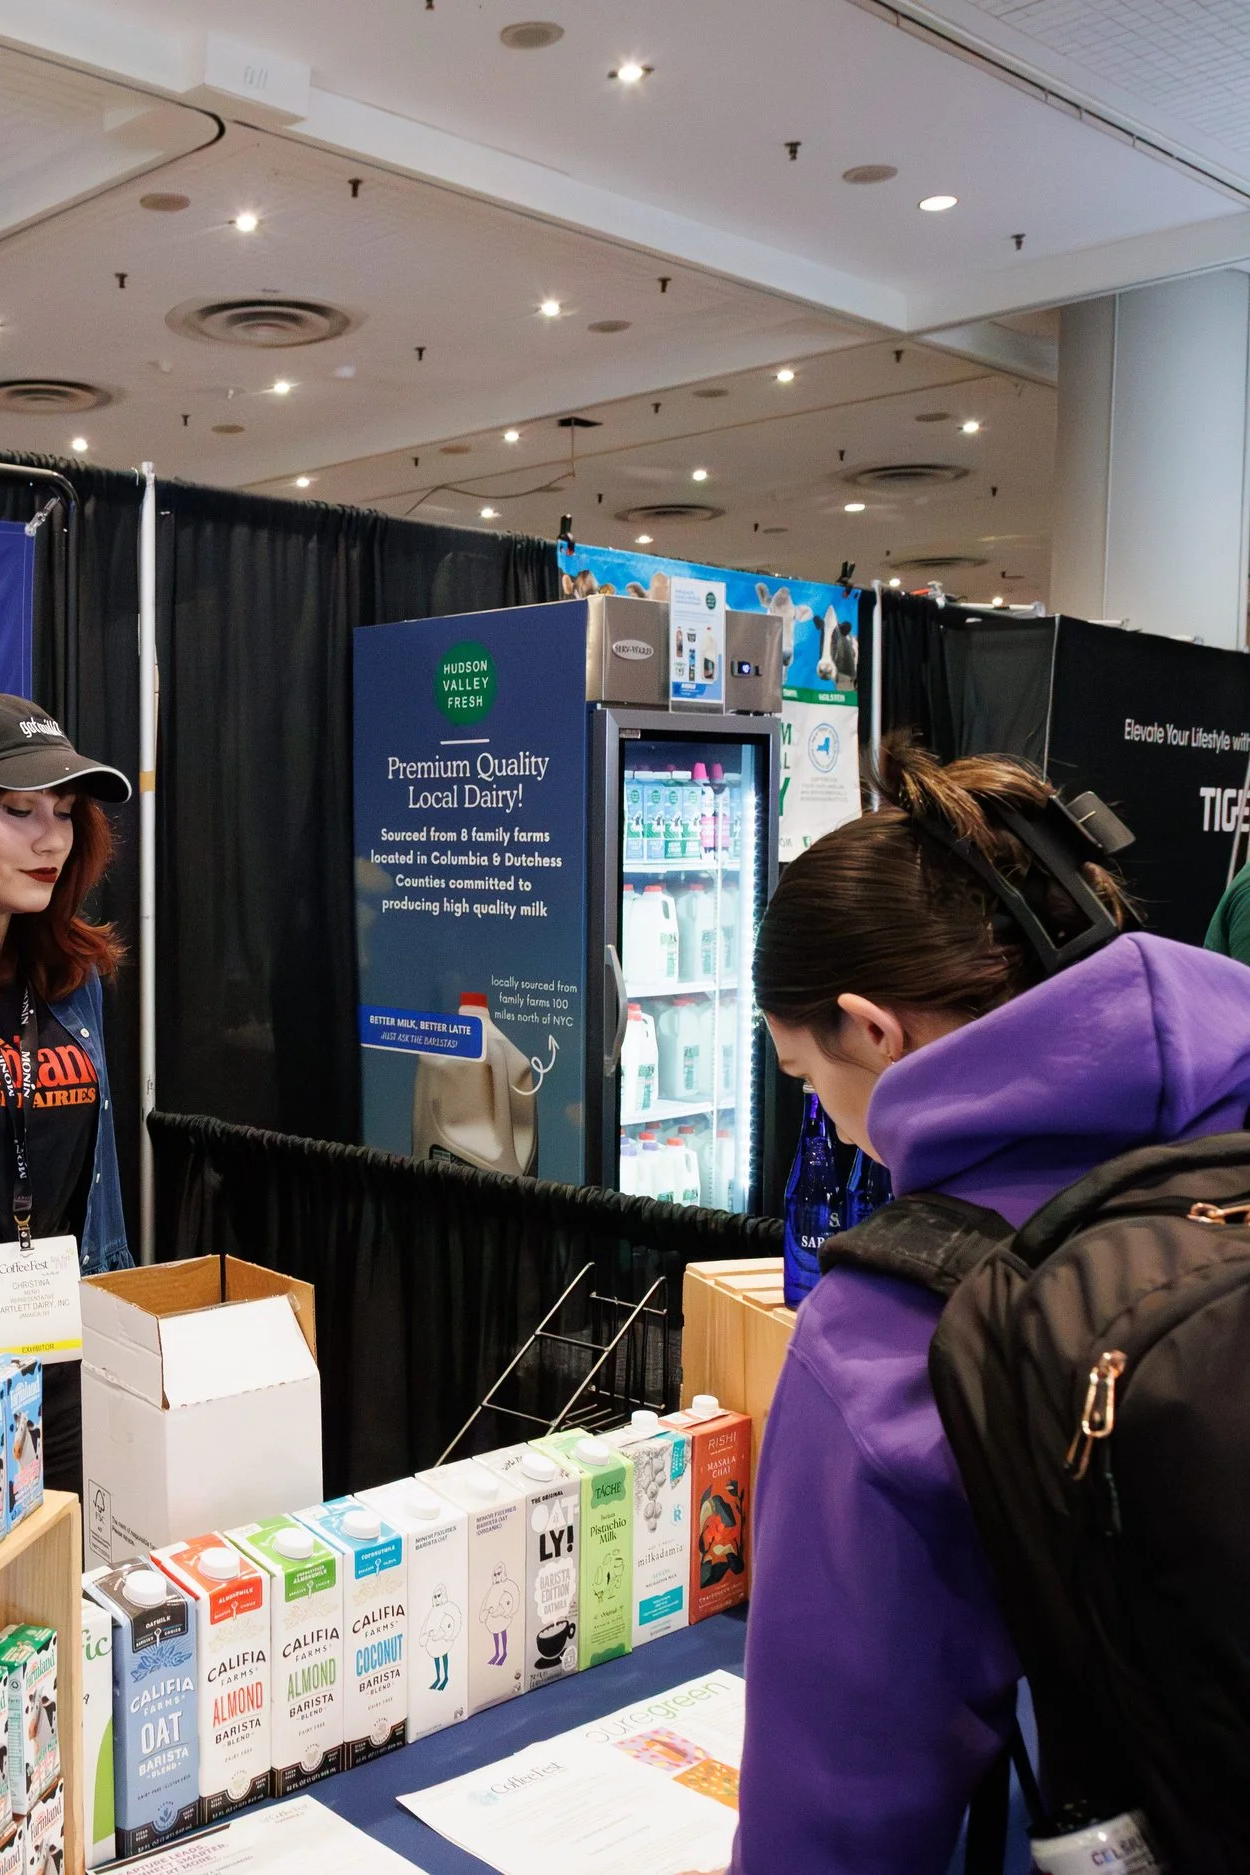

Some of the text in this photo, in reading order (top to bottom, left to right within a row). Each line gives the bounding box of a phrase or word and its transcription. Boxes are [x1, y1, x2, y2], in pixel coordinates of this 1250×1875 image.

[444, 660, 488, 674] HUDSON
[443, 677, 489, 691] VALLEY
[448, 696, 483, 708] FRESH
[1124, 718, 1164, 744] Elevate
[1166, 723, 1190, 746] Your
[1191, 727, 1230, 754] Lifestyle
[387, 751, 549, 781] Premium Quality
[408, 783, 523, 813] Local Dairy!
[381, 827, 550, 846] Sourced from 8 family farms
[370, 850, 562, 867] located in Columbia & Dutchess
[396, 874, 532, 891] Counties committed to
[382, 896, 548, 920] producing high quality milk
[491, 974, 577, 993] locally sourced from
[499, 992, 568, 1009] family farms 100
[370, 1015, 471, 1035] BETTER MILK, BETTER LATTE
[494, 1009, 574, 1027] miles north of NYC
[397, 1033, 409, 1042] ASK
[410, 1034, 423, 1044] THE
[17, 1087, 96, 1109] AIRIES
[21, 1343, 55, 1354] EXHIBITOR
[708, 1431, 738, 1450] RISHI
[707, 1457, 737, 1472] MASALA
[712, 1467, 731, 1479] CHAI
[531, 1496, 541, 1505] THE
[590, 1518, 627, 1538] Pistachio
[599, 1531, 617, 1544] Milk
[539, 1525, 574, 1562] LY!
[540, 1568, 570, 1589] BARISTA
[541, 1582, 569, 1604] EDITION
[145, 1616, 171, 1629] OATMILK
[352, 1604, 405, 1634] CALIFIA
[365, 1621, 395, 1638] FARMS
[282, 1627, 340, 1658] CALIFIA
[295, 1645, 327, 1662] FARMS
[356, 1634, 403, 1677] COCONUT
[207, 1650, 266, 1683] CALIFIA
[221, 1669, 253, 1686] FARMS
[287, 1658, 336, 1702] ALMOND
[359, 1669, 401, 1693] BARISTA
[130, 1677, 194, 1713] CALIFIA
[213, 1681, 263, 1728] ALMOND
[144, 1696, 180, 1716] FARMS
[289, 1693, 334, 1718] BARISTA
[141, 1711, 183, 1755] OAT
[215, 1718, 261, 1744] BARISTA
[138, 1747, 189, 1777] BARISTA
